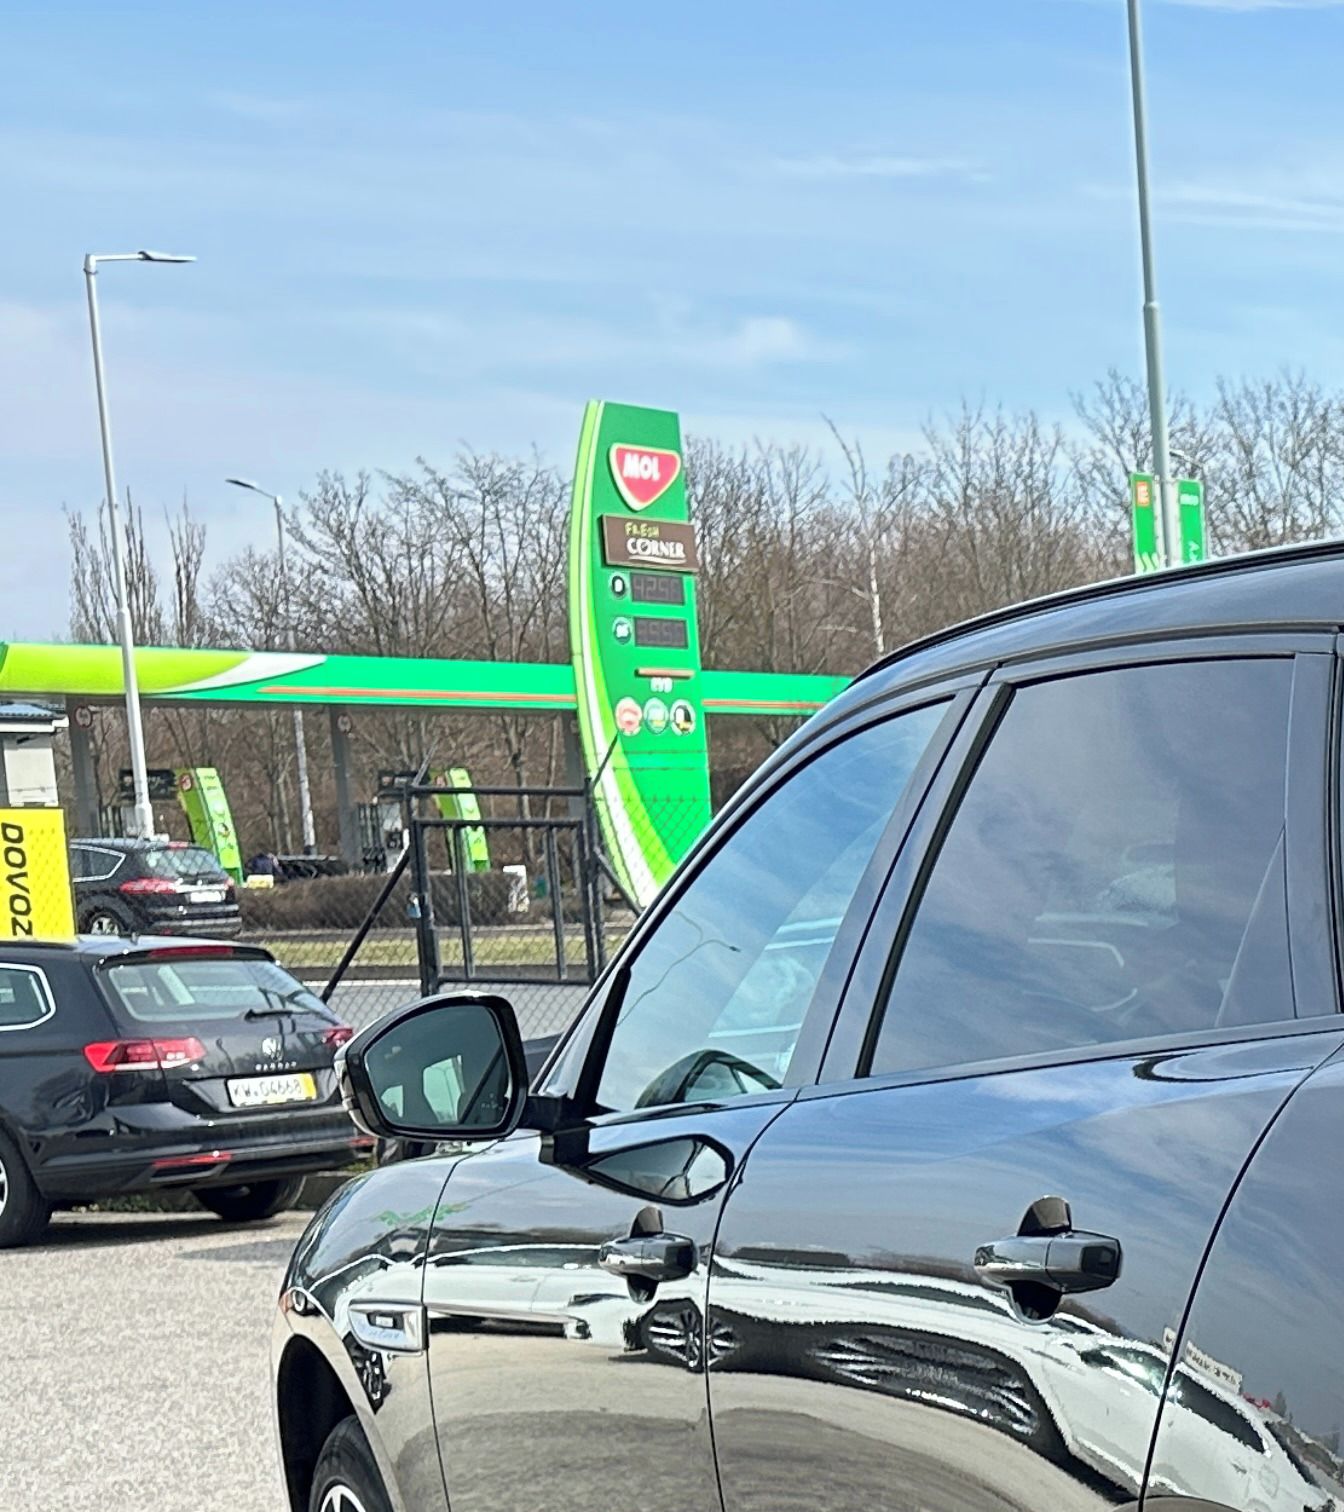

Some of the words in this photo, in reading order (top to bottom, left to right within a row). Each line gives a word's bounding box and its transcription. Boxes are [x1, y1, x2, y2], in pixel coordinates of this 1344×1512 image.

[623, 453, 660, 481] MOL
[627, 537, 686, 560] CORNER
[1, 822, 33, 937] DOVOZ
